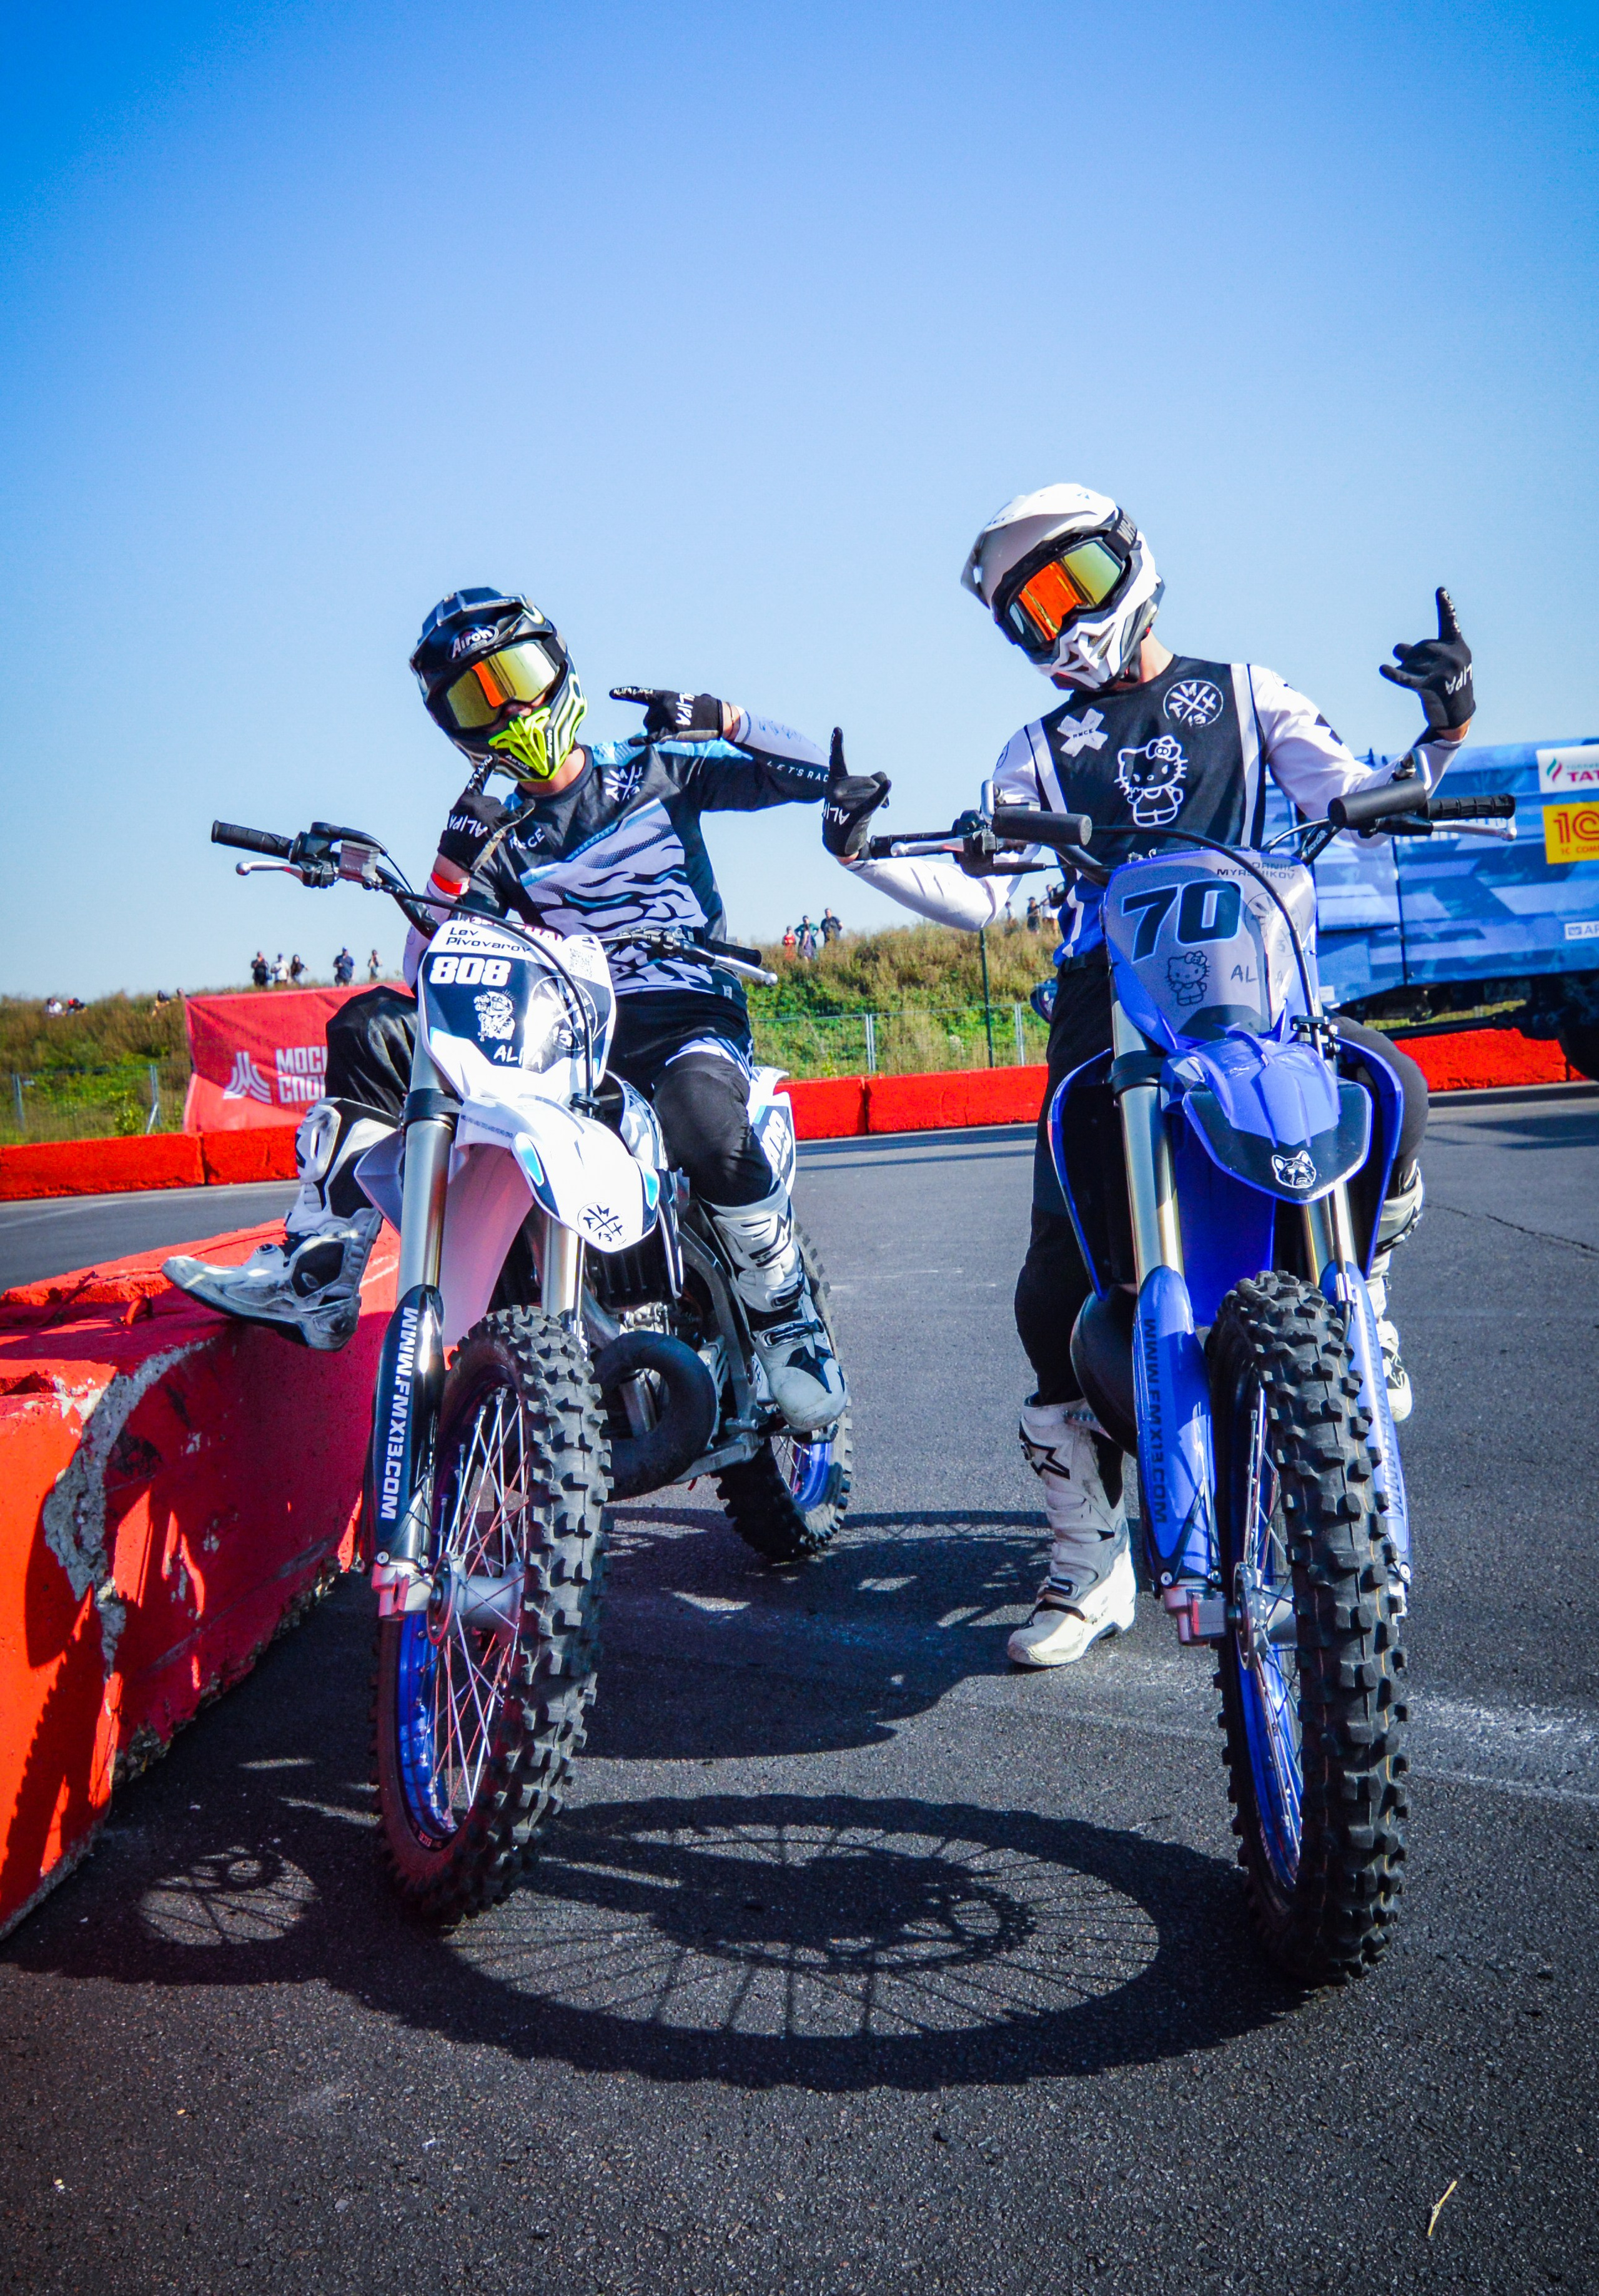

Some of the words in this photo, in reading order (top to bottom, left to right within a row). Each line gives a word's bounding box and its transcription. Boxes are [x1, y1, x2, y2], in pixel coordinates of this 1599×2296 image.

[452, 627, 493, 658] Airoh
[767, 761, 804, 777] LET'S
[448, 814, 488, 837] ALIPA
[1122, 878, 1244, 963] 70
[446, 937, 532, 952] Pivovarov
[429, 956, 512, 987] 808
[381, 1306, 418, 1520] WWW.FMX13.COM
[1144, 1318, 1167, 1524] WWW.FMX13.COM
